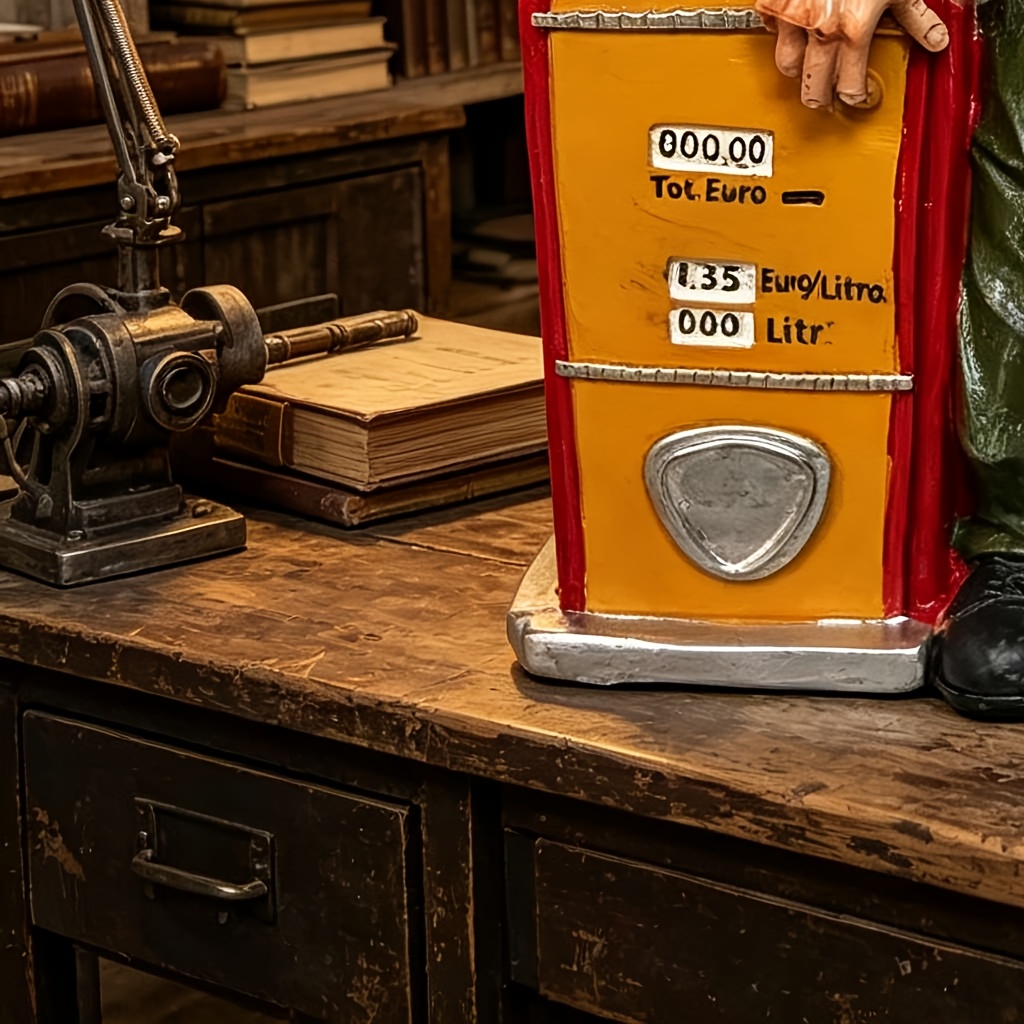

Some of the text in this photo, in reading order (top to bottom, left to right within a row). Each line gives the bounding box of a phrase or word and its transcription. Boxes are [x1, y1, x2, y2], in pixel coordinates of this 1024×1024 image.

[705, 178, 767, 205] Euro
[677, 262, 741, 293] 1.35
[678, 309, 740, 337] 000
